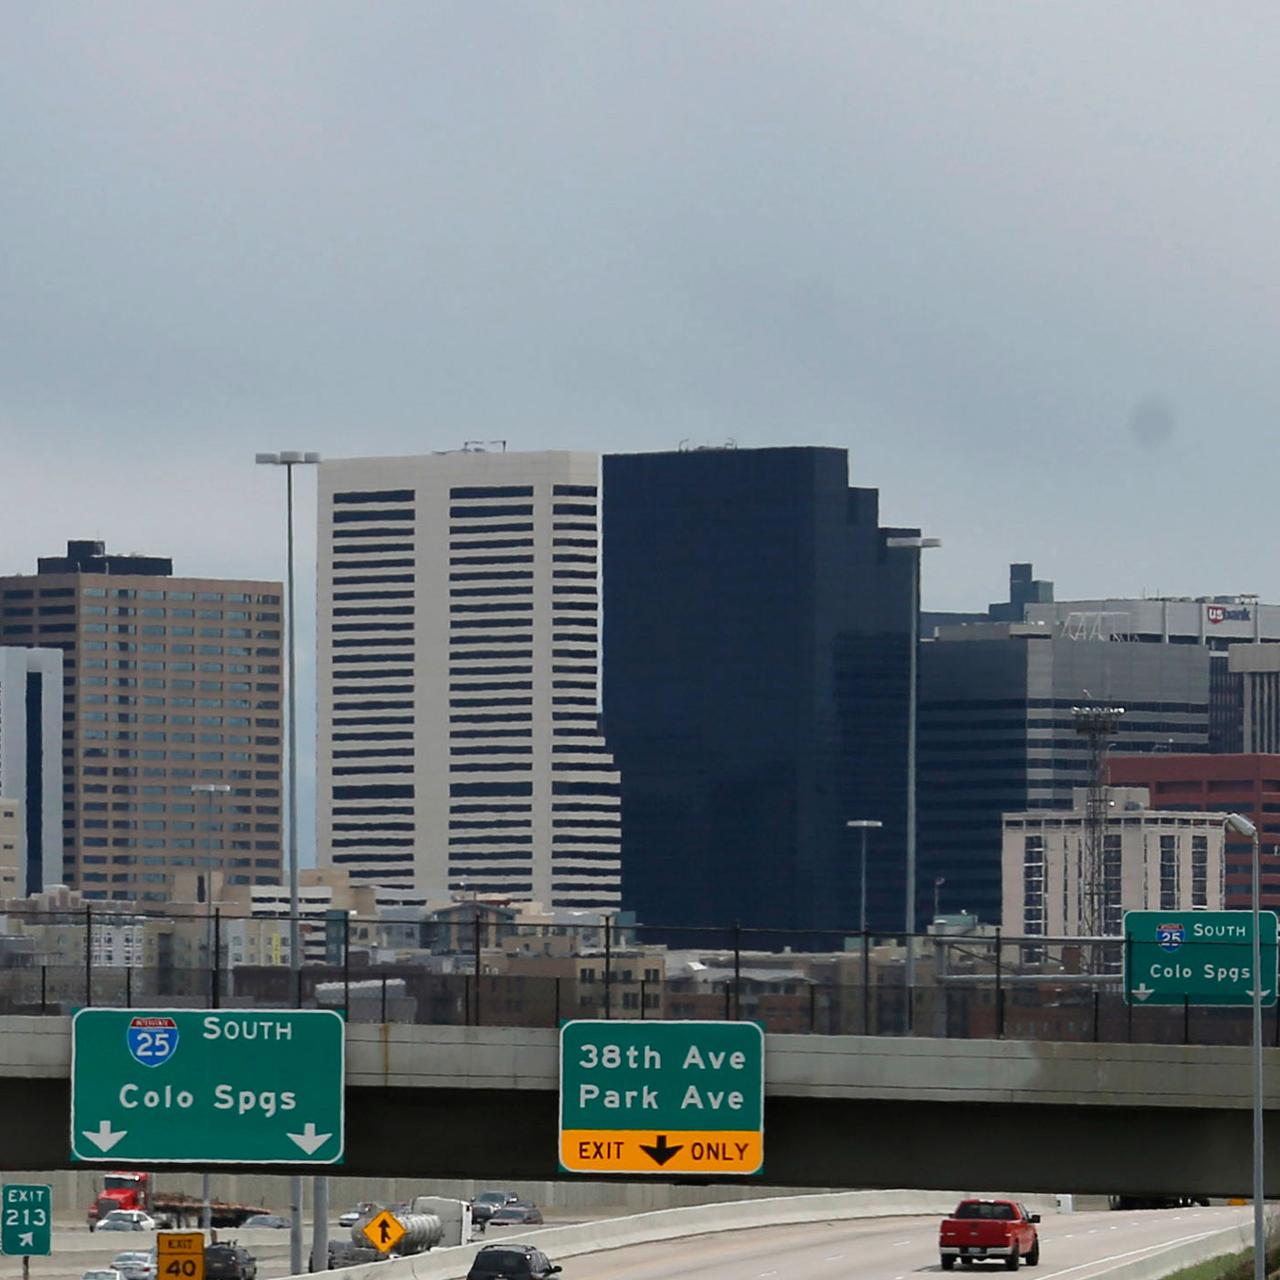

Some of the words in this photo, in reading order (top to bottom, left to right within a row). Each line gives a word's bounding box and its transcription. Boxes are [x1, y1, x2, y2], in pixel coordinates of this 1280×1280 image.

[1193, 923, 1246, 937] SOUTH
[1150, 964, 1192, 978] Colo
[1204, 964, 1251, 982] Spgs
[203, 1016, 293, 1041] SOUTH
[136, 1033, 170, 1057] 25
[579, 1044, 661, 1070] 38th
[682, 1044, 747, 1070] Ave
[119, 1083, 194, 1109] Colo
[213, 1084, 296, 1118] Spgs
[579, 1084, 659, 1109] Park
[680, 1085, 745, 1110] Ave
[579, 1142, 624, 1160] EXIT
[691, 1142, 749, 1161] ONLY
[8, 1190, 45, 1202] EXIT
[6, 1209, 46, 1226] 213
[168, 1239, 192, 1249] EXIT
[166, 1260, 195, 1277] 40
